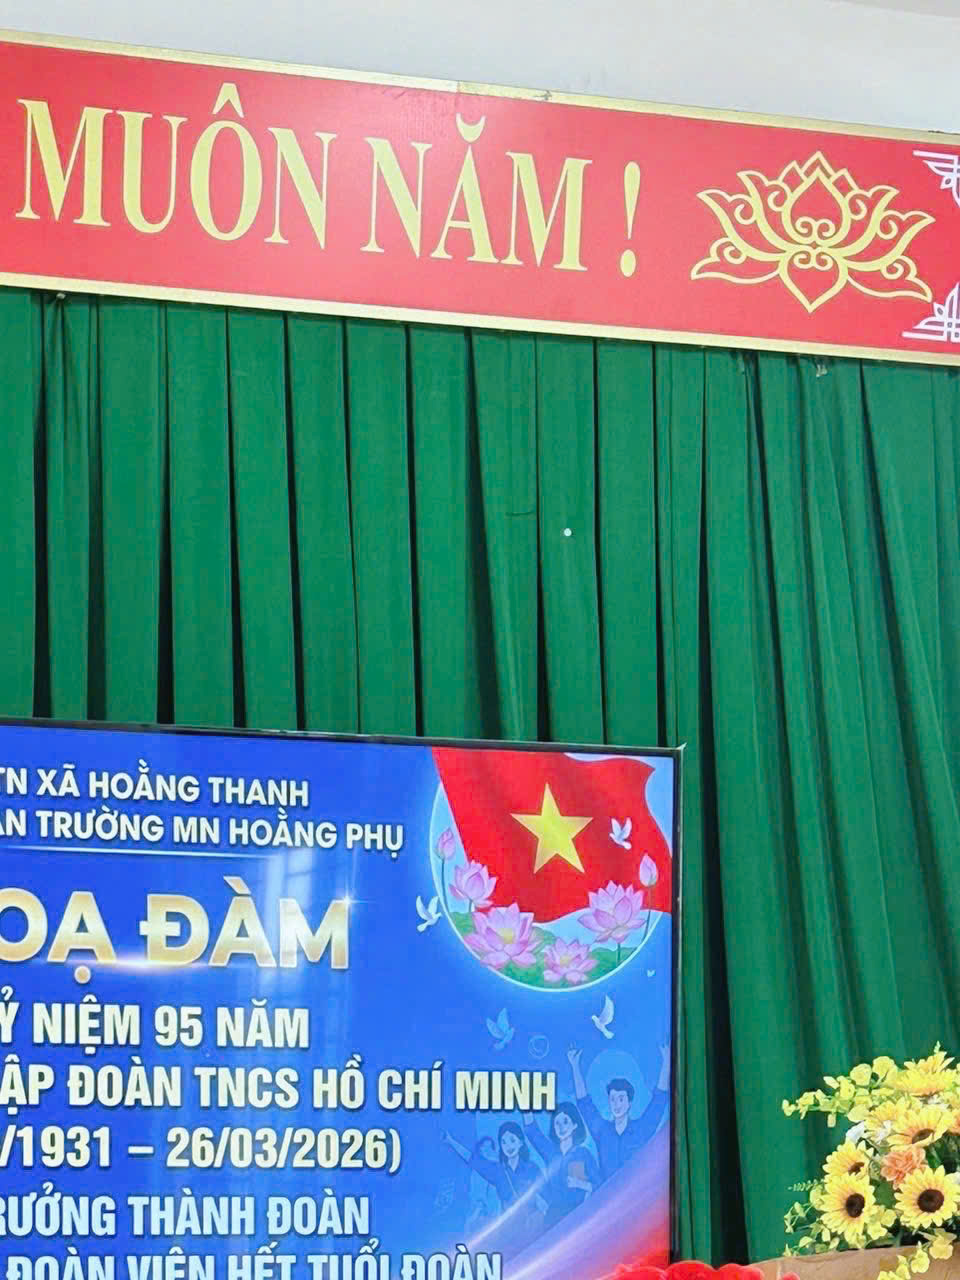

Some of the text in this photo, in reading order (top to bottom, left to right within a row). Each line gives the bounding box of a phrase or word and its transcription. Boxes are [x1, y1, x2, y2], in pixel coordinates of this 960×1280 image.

[15, 83, 336, 250] MUÔN
[361, 113, 593, 273] NĂM
[619, 161, 641, 278] !
[36, 763, 80, 797] XÃ
[89, 759, 200, 802] HOẰNG
[208, 776, 309, 807] THANH
[36, 805, 164, 842] TRƯỜNG
[173, 816, 220, 844] MN
[230, 807, 337, 848] HOẰNG
[346, 823, 403, 858] PHỤ
[139, 876, 350, 969] ĐÀM
[33, 994, 140, 1054] NIỆM
[155, 1005, 203, 1048] 95
[217, 999, 309, 1048] NĂM
[67, 1056, 180, 1107] ĐOÀN
[194, 1066, 298, 1109] TNCS
[313, 1055, 364, 1109] HỒ
[379, 1060, 441, 1110] CHÍ
[455, 1071, 556, 1111] MINH
[166, 1126, 401, 1172] 26/03/2026)
[127, 1188, 256, 1236] THÀNH
[266, 1188, 369, 1235] ĐOÀN
